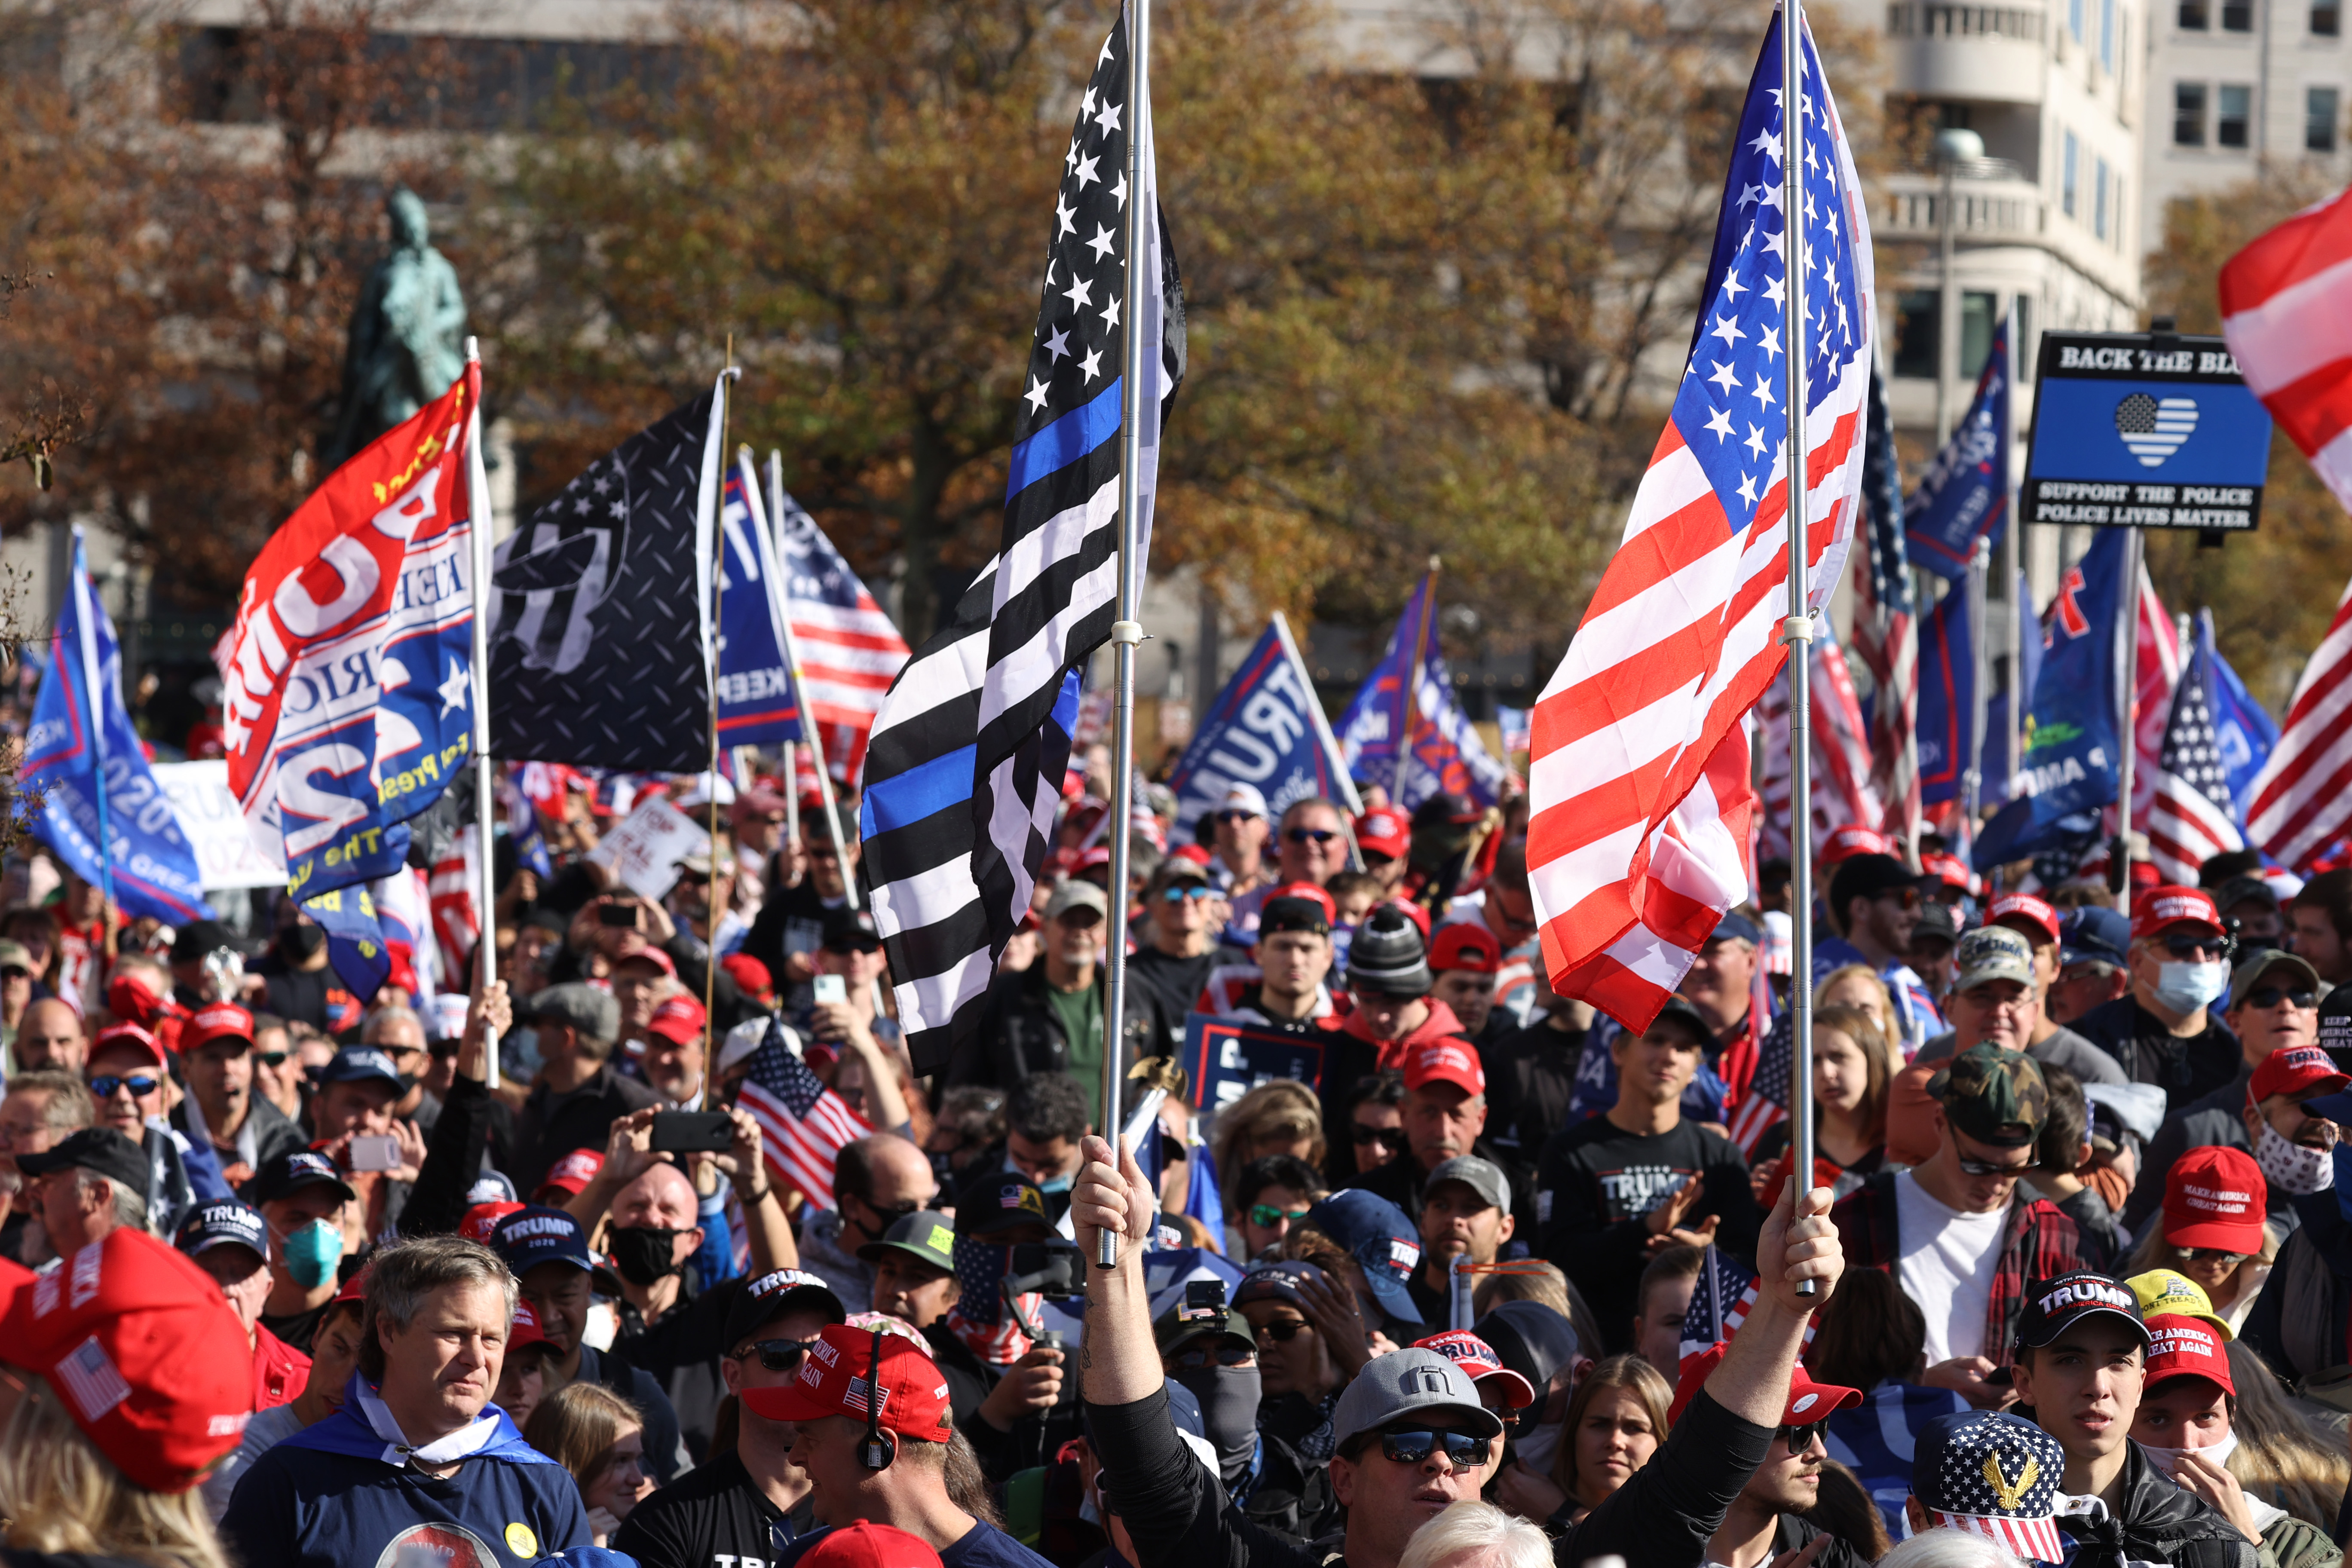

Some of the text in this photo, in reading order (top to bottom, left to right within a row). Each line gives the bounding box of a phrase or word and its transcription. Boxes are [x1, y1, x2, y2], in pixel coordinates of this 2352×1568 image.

[2060, 347, 2133, 370] BACK
[2139, 350, 2193, 373] THE
[2038, 482, 2253, 506] SUPPORT THE POLICE
[2035, 504, 2251, 528] POLICE LIVES MATTER
[2319, 1027, 2352, 1038] AMERIC
[2184, 1184, 2251, 1203] MAKE AMERICA
[2186, 1197, 2246, 1214] GREAT AGAIN
[201, 1205, 263, 1231] TRUMP
[502, 1217, 575, 1244] TRUMP
[528, 1238, 555, 1248] 2020
[2054, 1275, 2114, 1286] 45TH PRESIDENT
[2038, 1283, 2132, 1314] TRUMP
[2164, 1296, 2196, 1305] TREAD
[2046, 1307, 2066, 1319] KEEP
[2067, 1300, 2104, 1309] AMERICA
[2165, 1328, 2214, 1345] AMERICA
[2179, 1340, 2213, 1357] AGAIN
